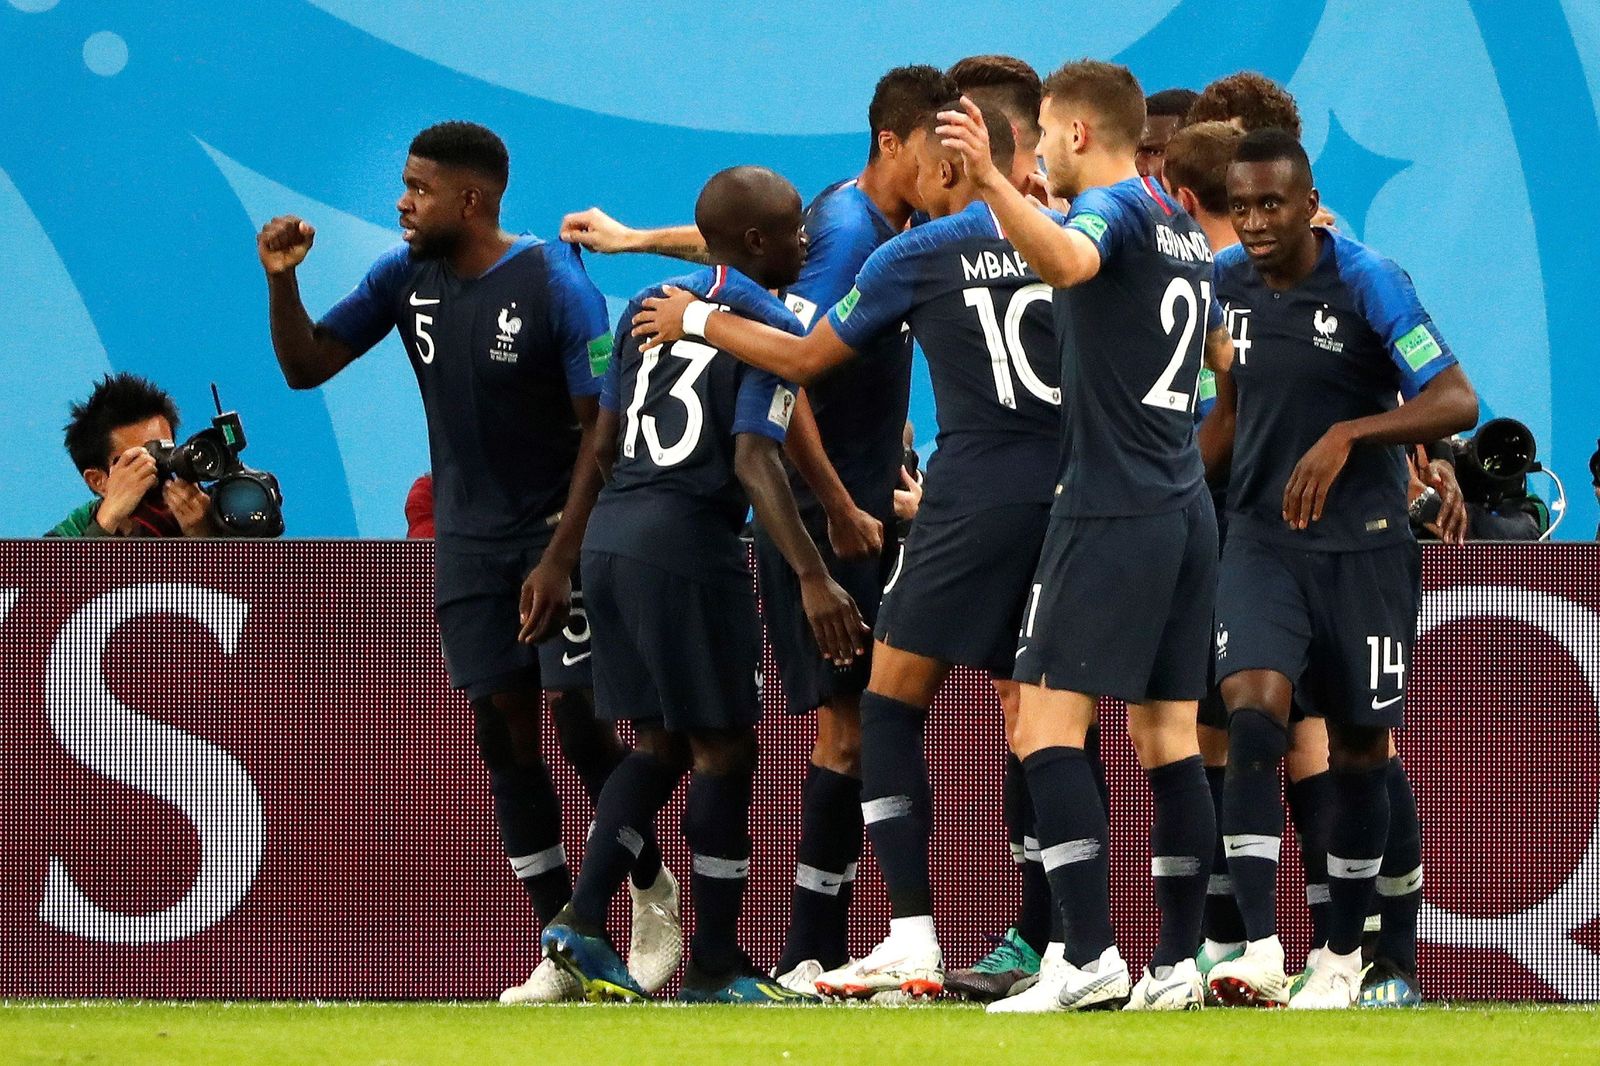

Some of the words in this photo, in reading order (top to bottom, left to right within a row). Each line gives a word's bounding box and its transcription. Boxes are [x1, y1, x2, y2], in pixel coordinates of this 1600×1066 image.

[960, 250, 1028, 281] MBAP
[1155, 224, 1214, 263] HERNANDE
[415, 312, 435, 364] 5
[623, 337, 719, 467] 13
[1366, 636, 1405, 690] 14
[0, 582, 268, 946] S
